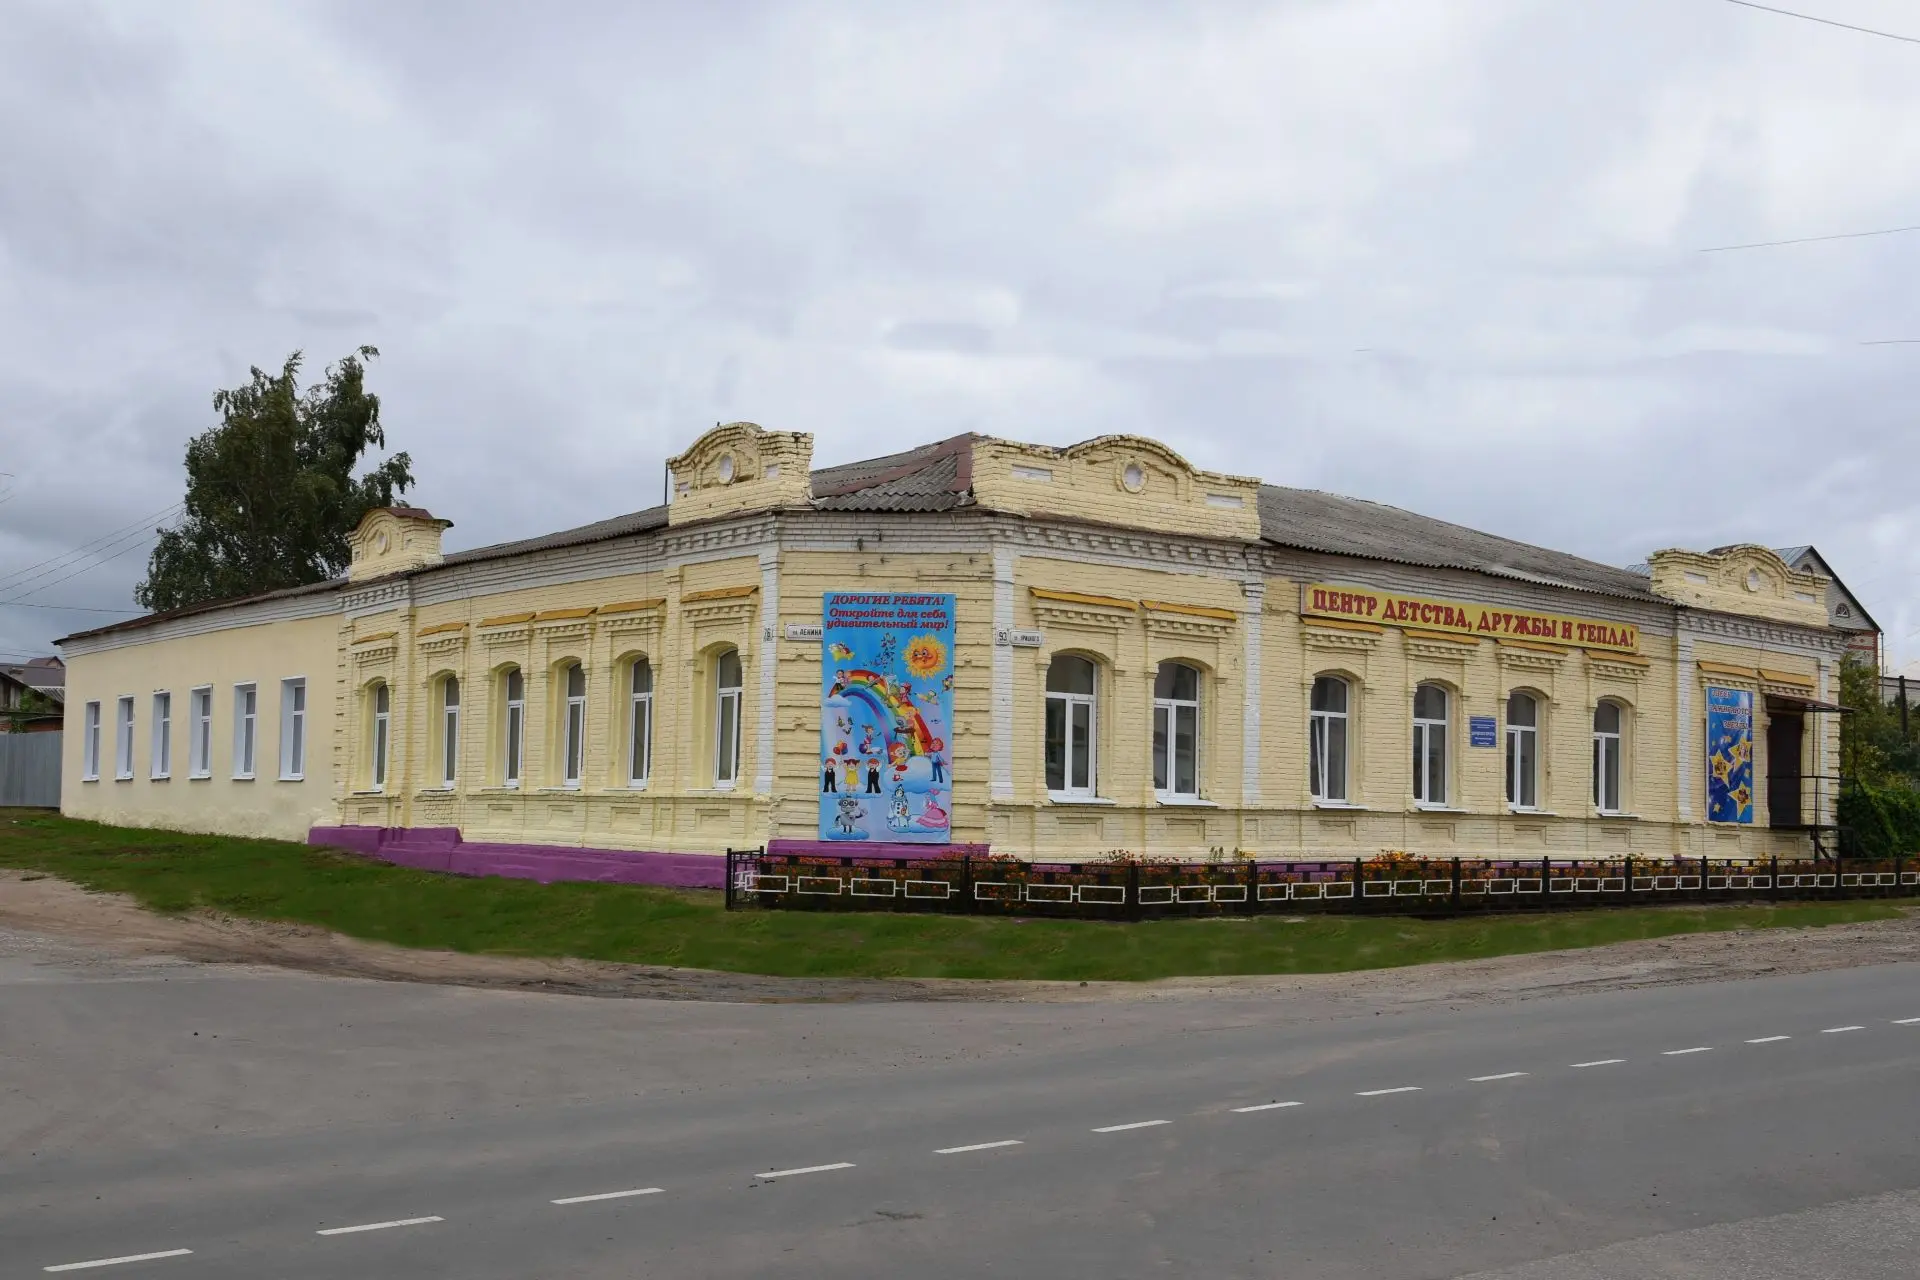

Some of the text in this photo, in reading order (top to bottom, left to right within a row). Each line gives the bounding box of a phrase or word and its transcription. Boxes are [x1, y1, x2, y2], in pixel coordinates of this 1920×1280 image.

[830, 595, 946, 606] ДОРОГИЕ РЕБЯТА!
[829, 607, 946, 619] Откройте для себя
[1312, 589, 1634, 648] ЦЕНТР ДЕТСТВА, ДРУЖБЫ И ТЕПЛА!
[826, 618, 949, 631] удивительный мир!
[998, 631, 1008, 642] 93
